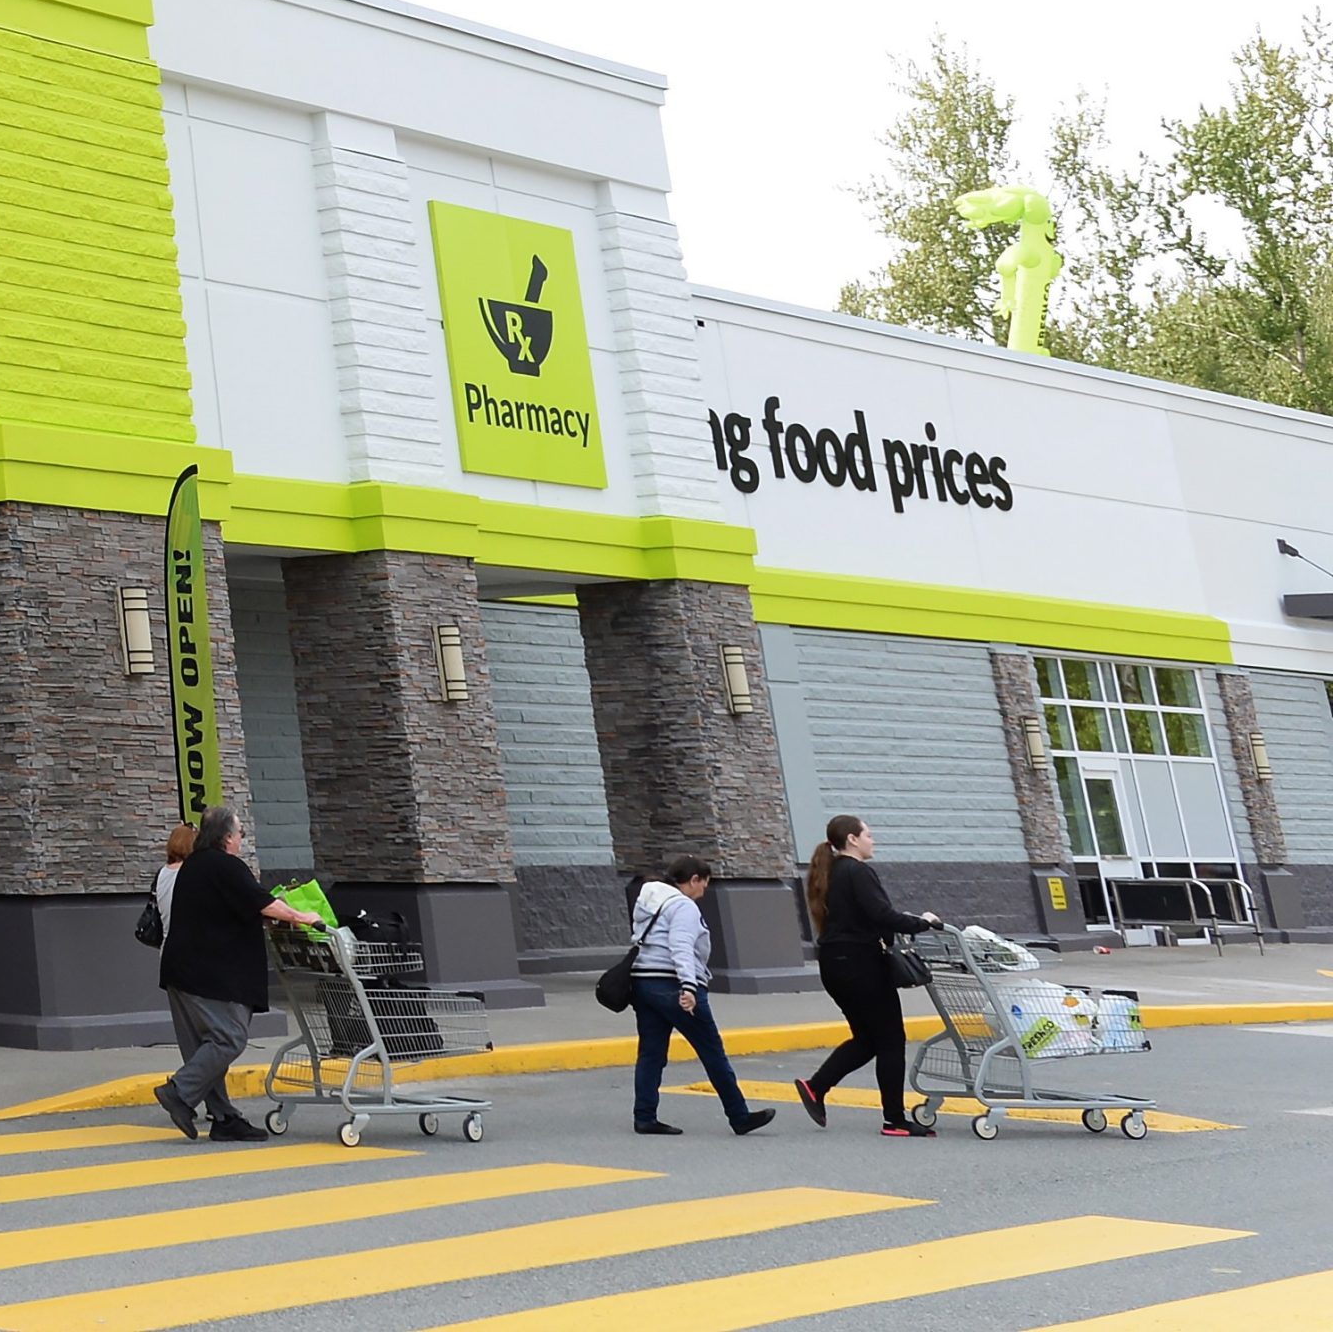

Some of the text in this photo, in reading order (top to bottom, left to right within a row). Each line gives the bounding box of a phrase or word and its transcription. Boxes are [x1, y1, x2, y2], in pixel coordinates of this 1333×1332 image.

[464, 382, 590, 448] Pharmacy
[762, 396, 878, 492] food
[882, 422, 1013, 513] prices
[173, 549, 207, 813] NOW OPEN!
